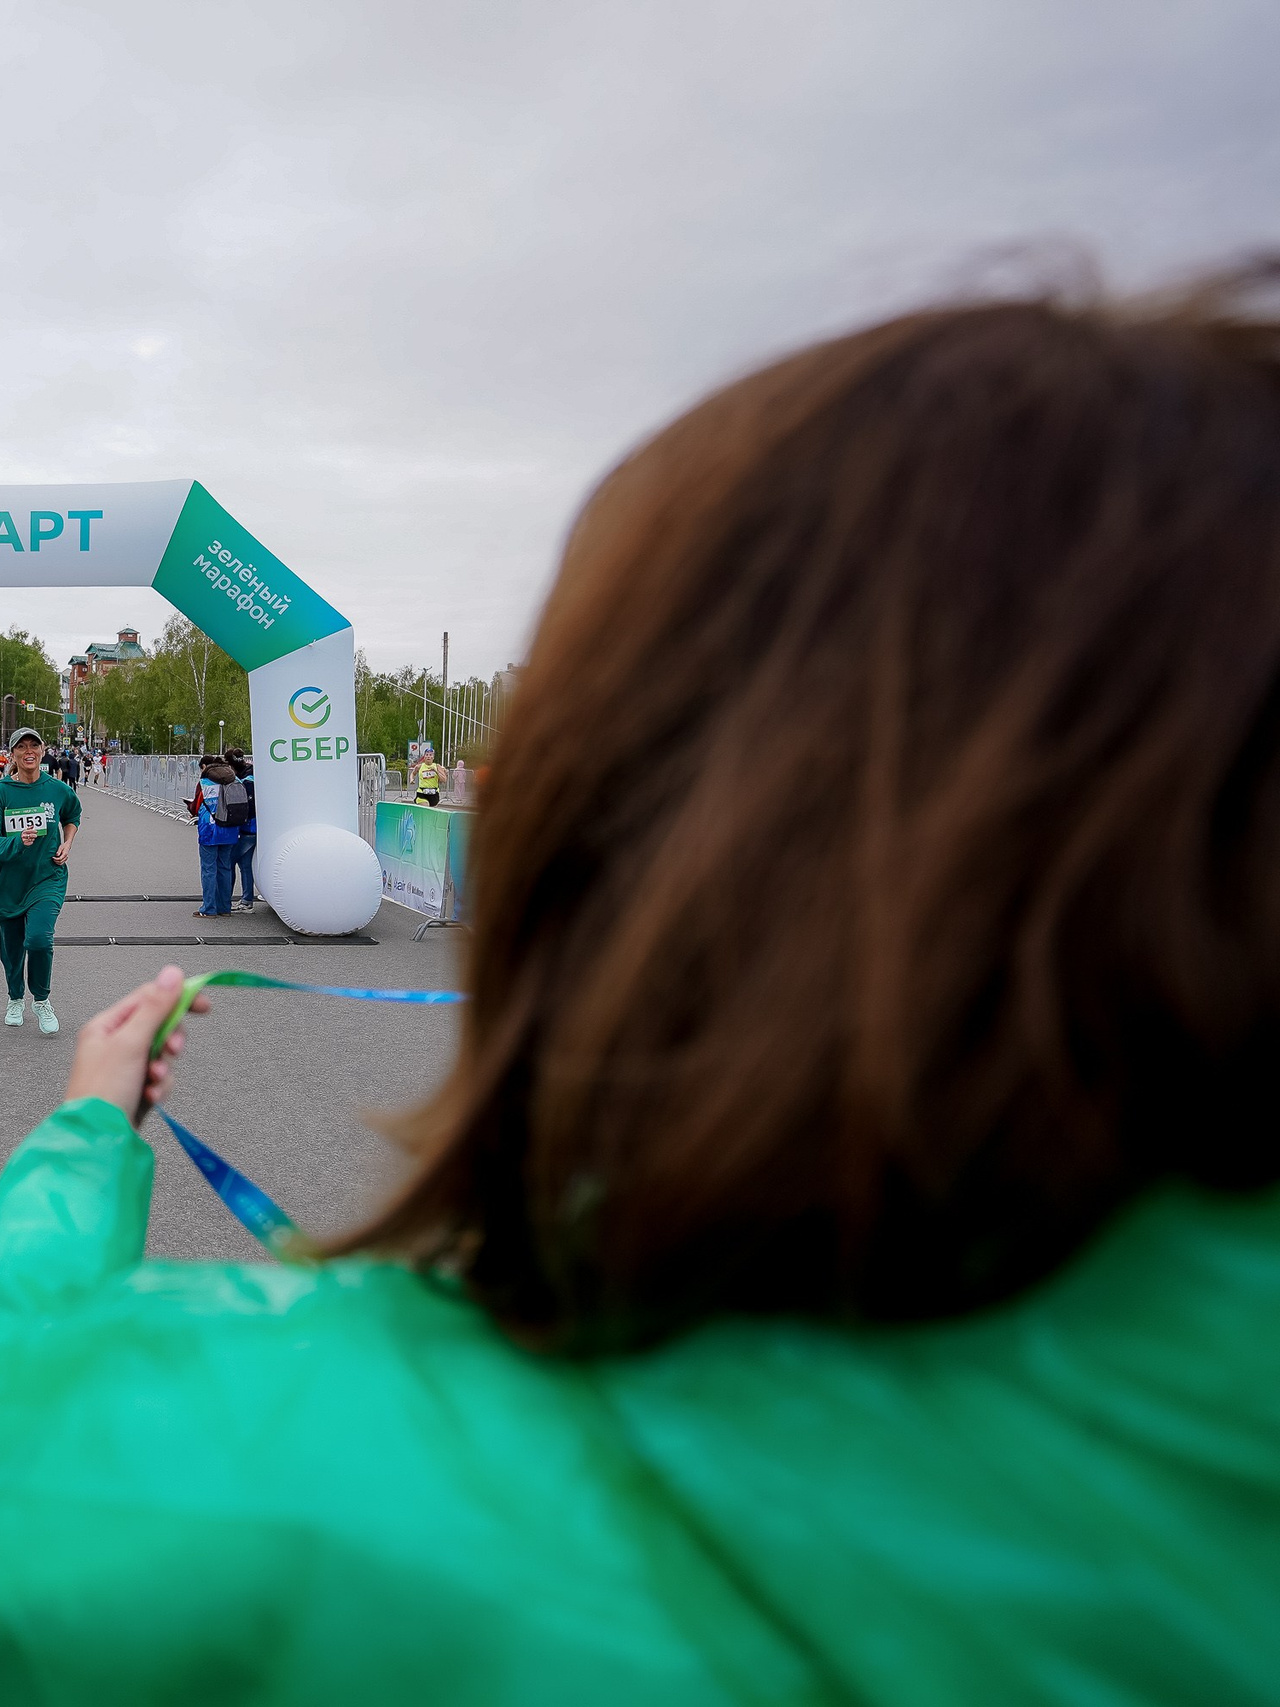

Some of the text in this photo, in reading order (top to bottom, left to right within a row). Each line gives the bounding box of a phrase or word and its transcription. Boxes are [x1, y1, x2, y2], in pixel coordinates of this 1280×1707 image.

[192, 554, 275, 630] марафон
[207, 540, 292, 615] зелёный
[269, 736, 350, 763] СБЕР
[9, 815, 43, 831] 1153
